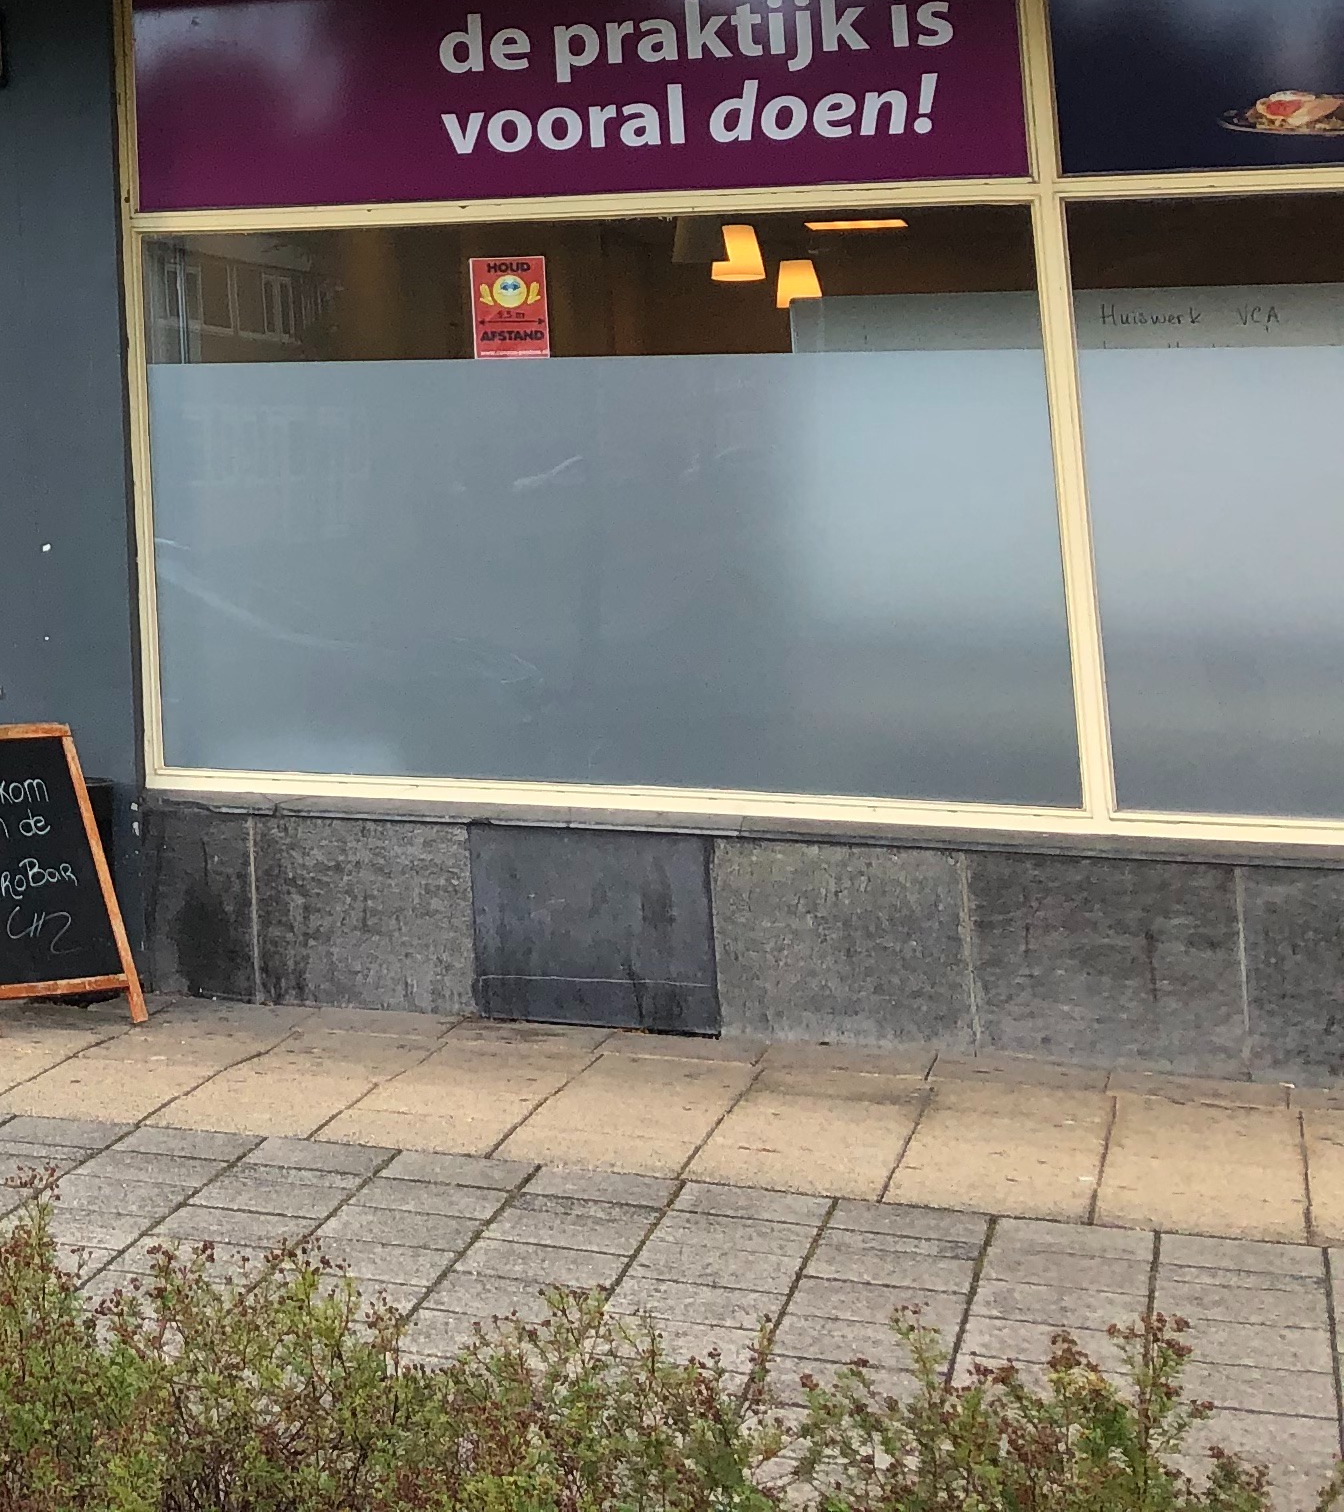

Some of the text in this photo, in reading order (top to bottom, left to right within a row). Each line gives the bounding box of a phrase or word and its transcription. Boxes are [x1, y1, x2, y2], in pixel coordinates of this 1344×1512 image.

[438, 12, 532, 73] de
[441, 72, 939, 155] vooral doen!
[487, 261, 531, 273] HOUD
[1100, 303, 1280, 326] Huiswerk VCA
[480, 330, 544, 342] AFSTAND
[18, 809, 52, 838] de
